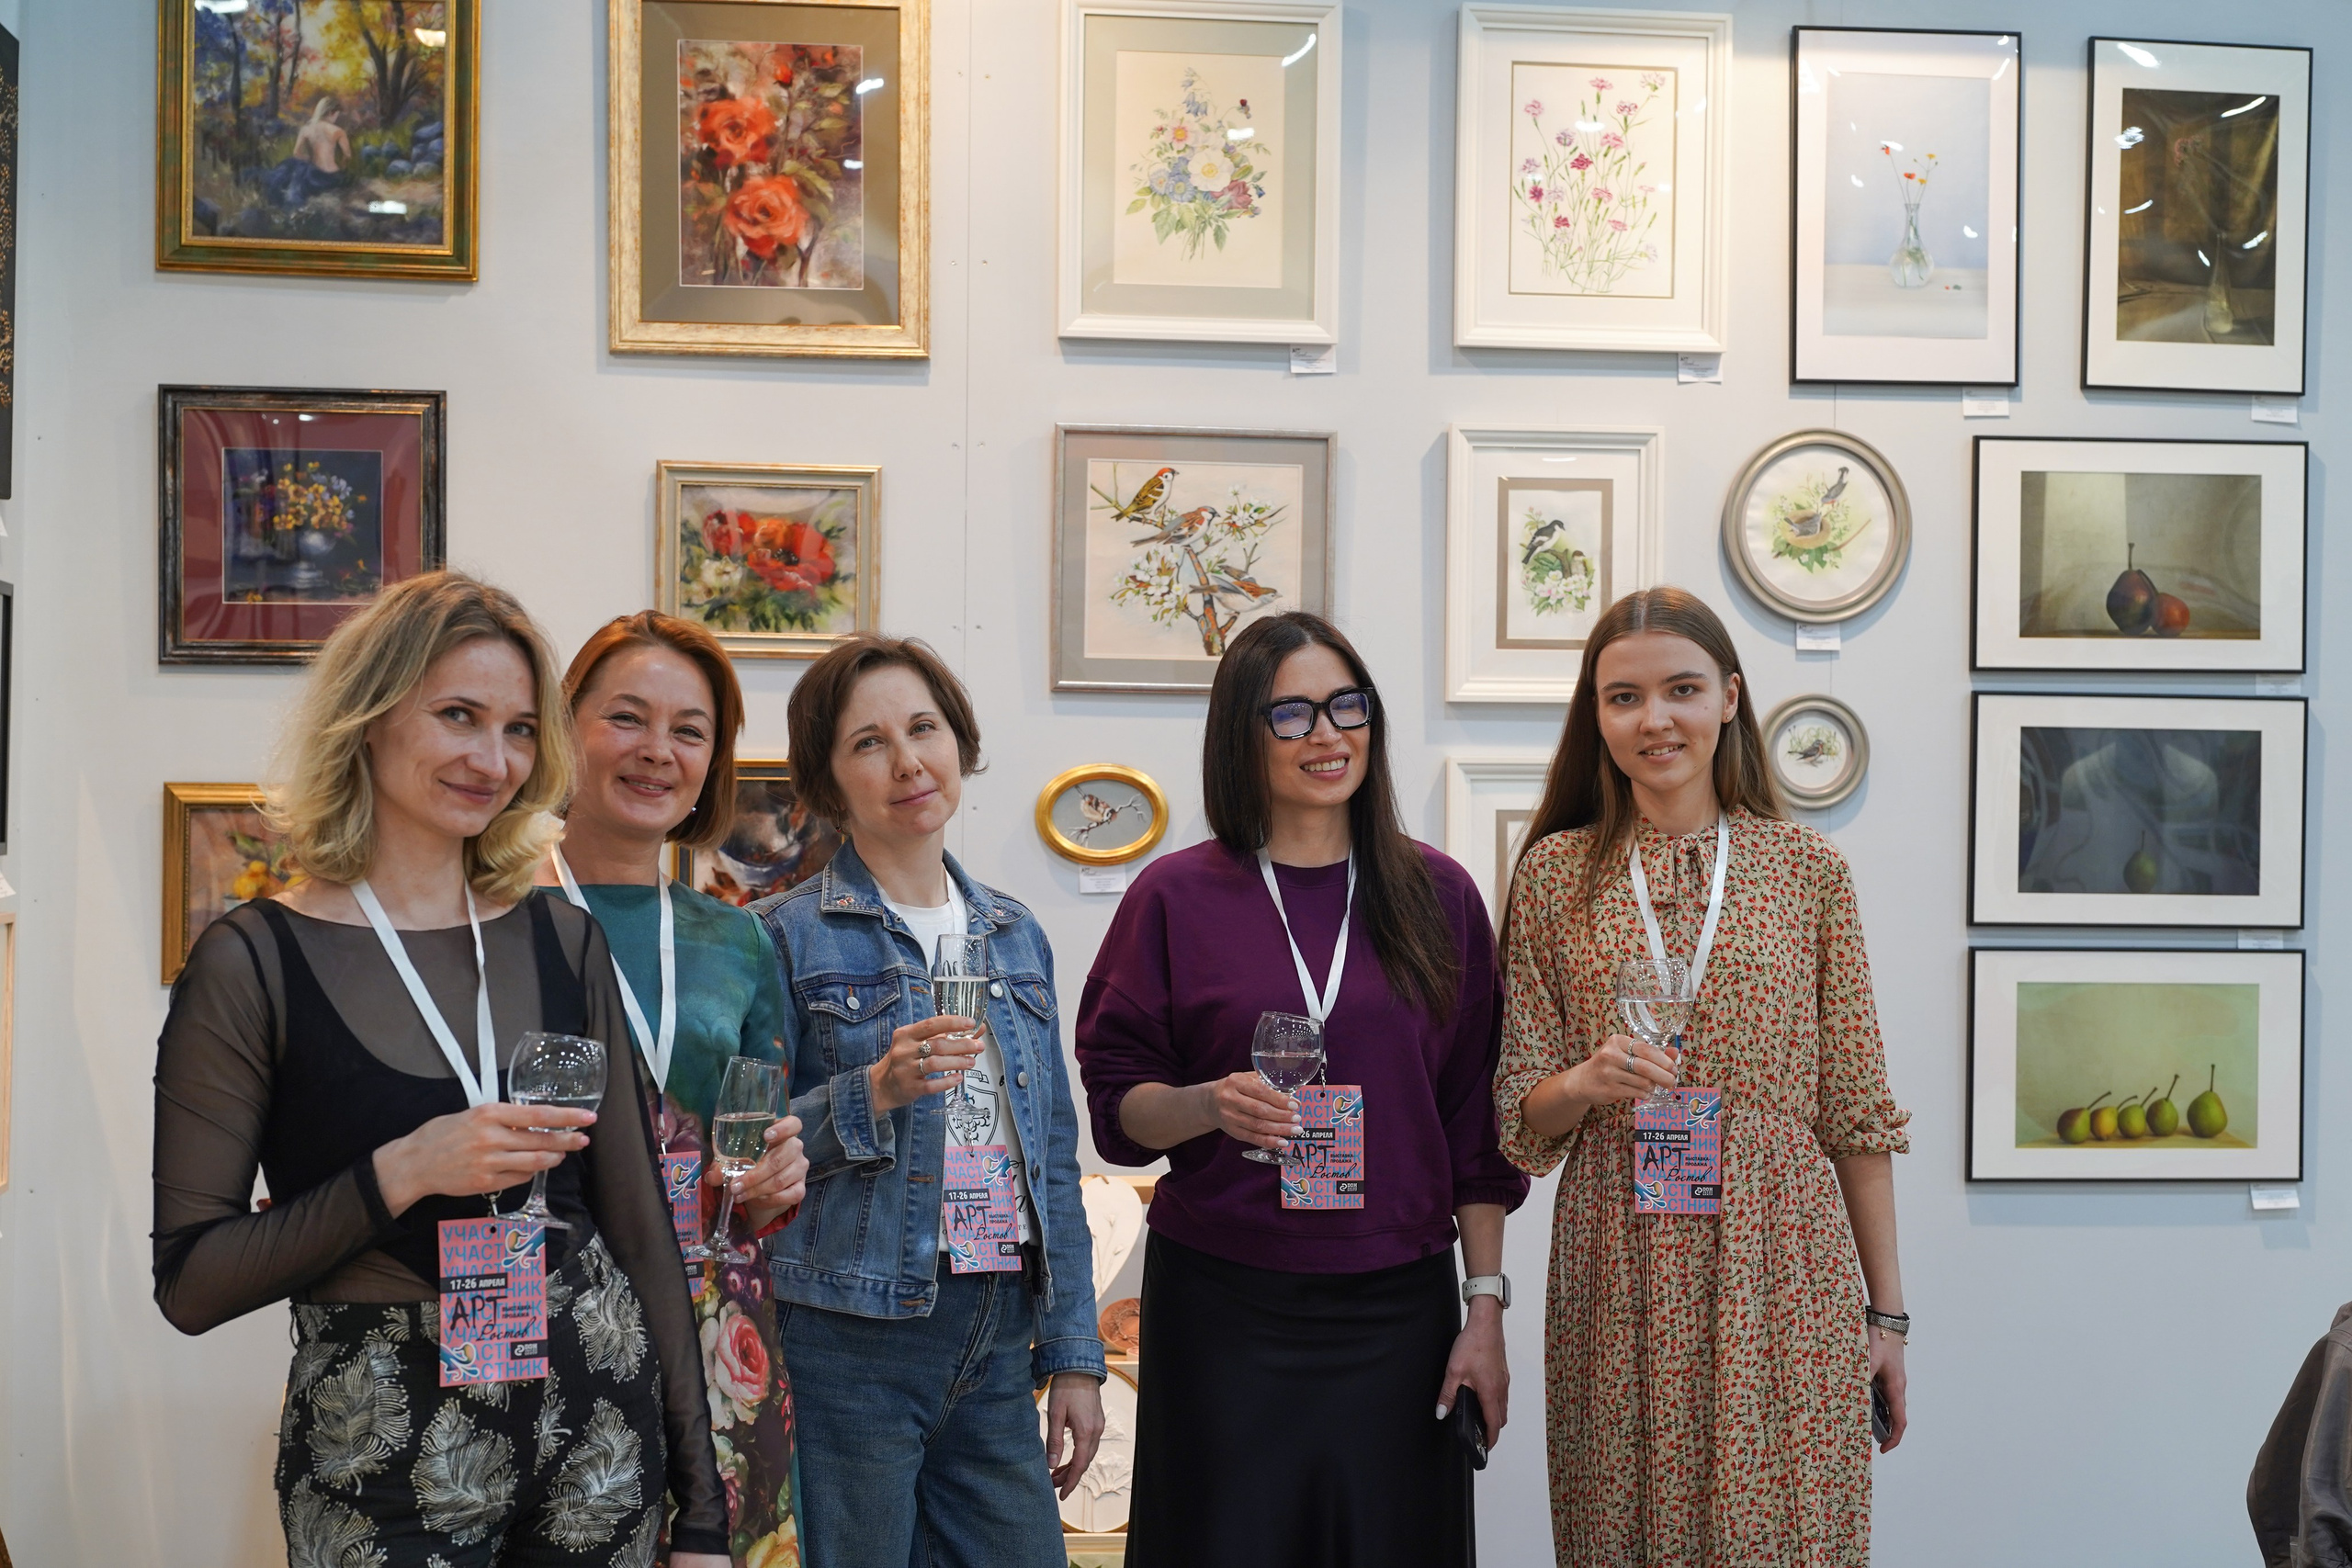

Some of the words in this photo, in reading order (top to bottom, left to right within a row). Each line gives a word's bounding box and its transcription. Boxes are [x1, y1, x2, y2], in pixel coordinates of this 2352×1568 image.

[1293, 1089, 1361, 1102] ЧАСТНИК
[945, 1150, 1004, 1164] ЧАСТНИК
[1290, 1143, 1335, 1168] АРТ
[1643, 1145, 1690, 1171] АРТ
[1309, 1162, 1357, 1179] Ростов
[1664, 1166, 1713, 1182] Ростов
[948, 1191, 968, 1200] 17-26
[954, 1204, 991, 1231] АРТ
[974, 1223, 1012, 1240] Ростов
[450, 1278, 477, 1291] 17-26
[479, 1278, 505, 1288] АПРЕЛЯ
[450, 1294, 508, 1330] АРТ
[476, 1315, 537, 1341] Ростов
